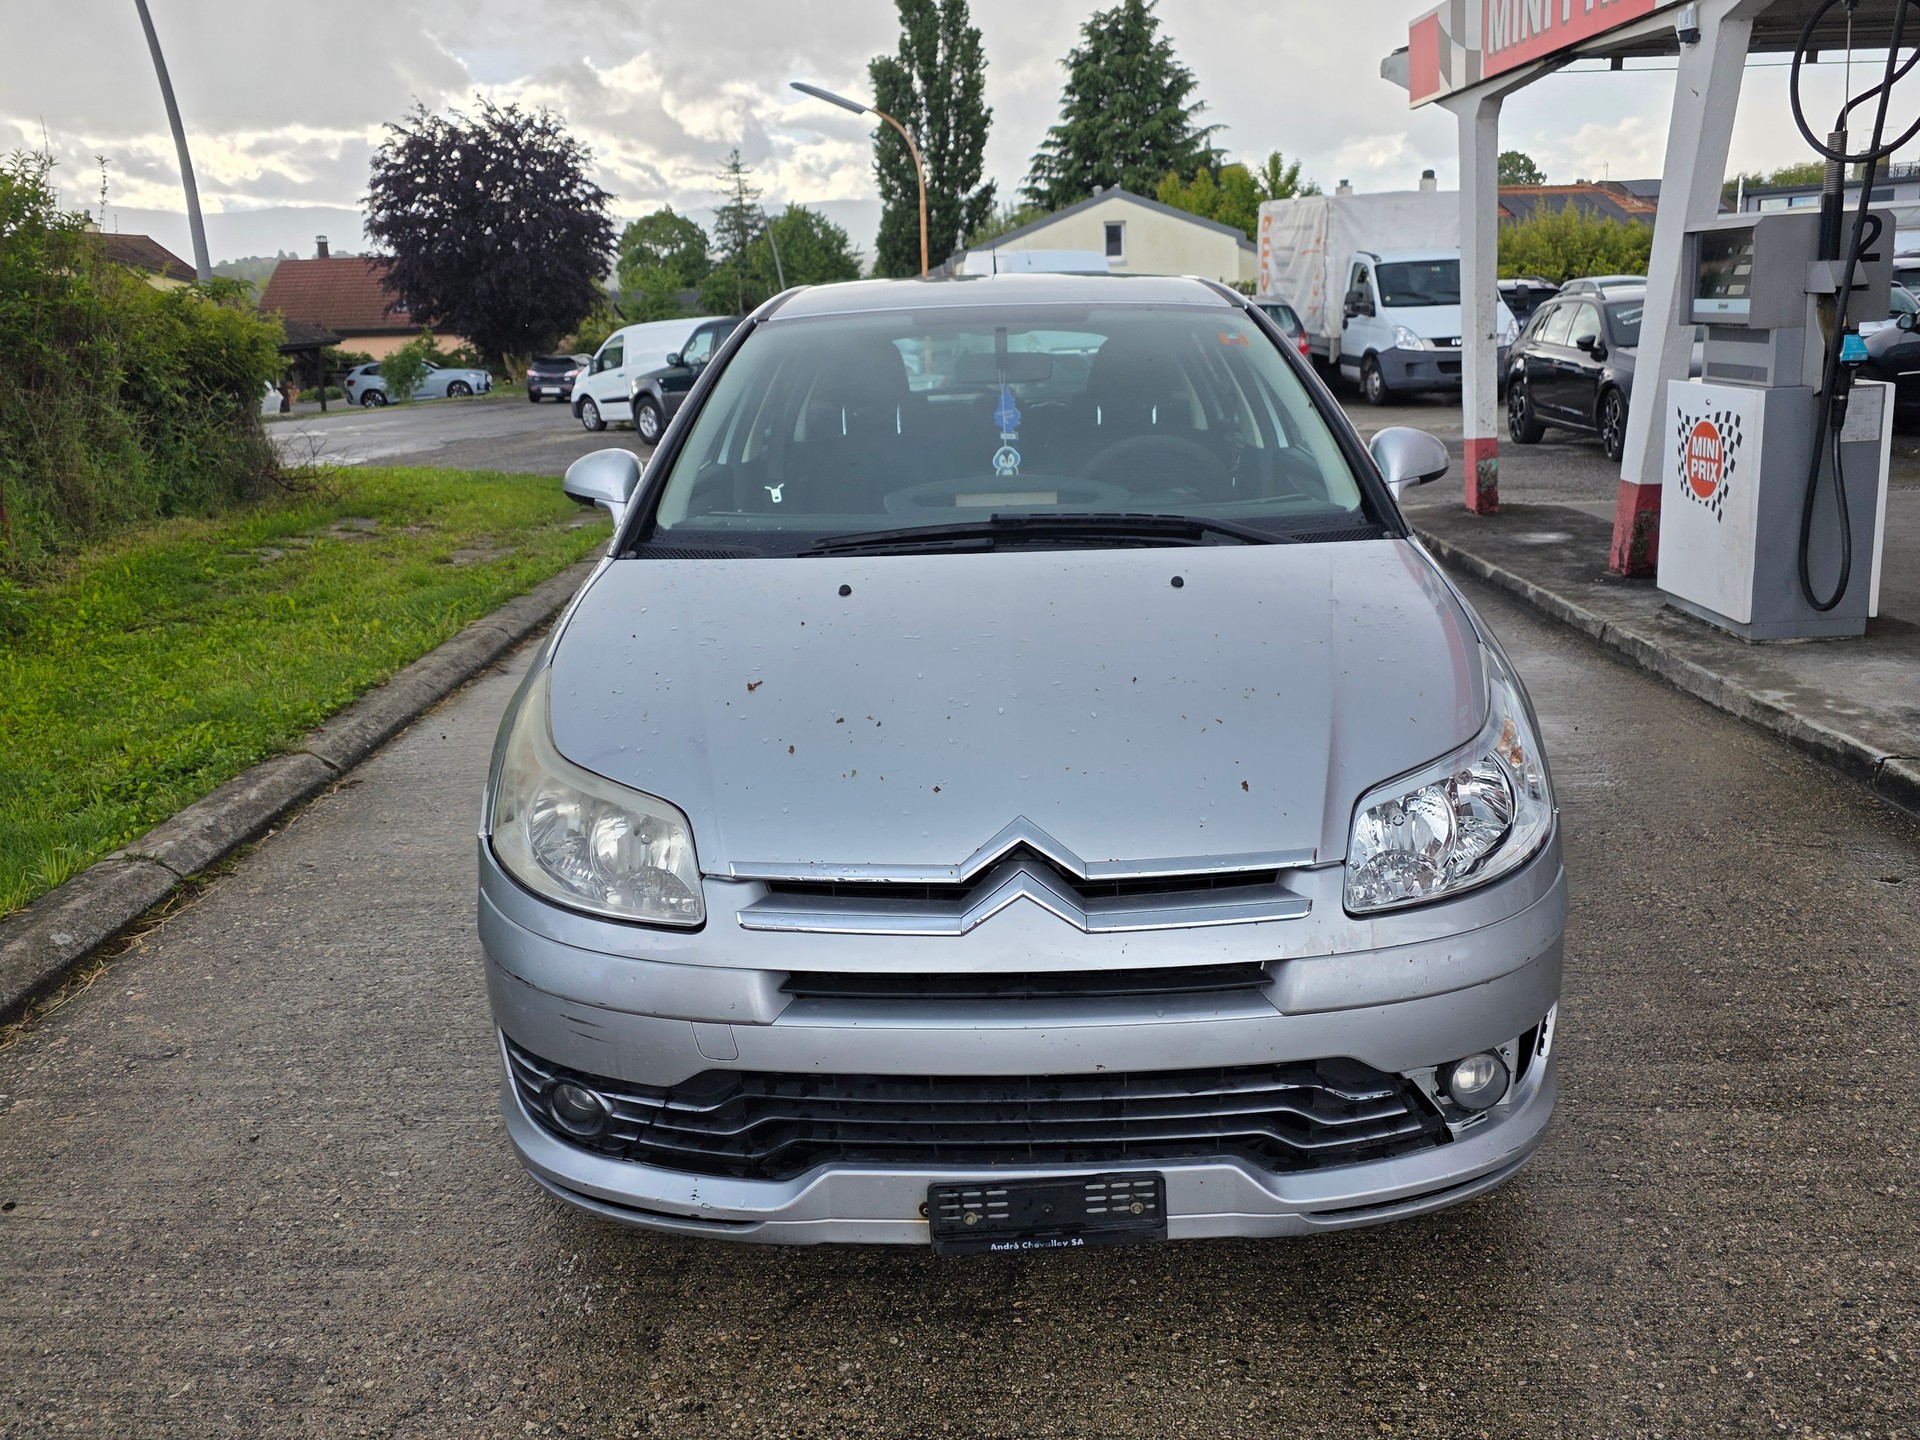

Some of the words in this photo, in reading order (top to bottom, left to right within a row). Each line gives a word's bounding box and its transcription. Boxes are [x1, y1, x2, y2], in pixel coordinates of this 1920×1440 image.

[1852, 214, 1883, 262] 2
[1691, 436, 1719, 460] MINI
[1690, 458, 1719, 483] PRIX
[1071, 1238, 1084, 1246] SA
